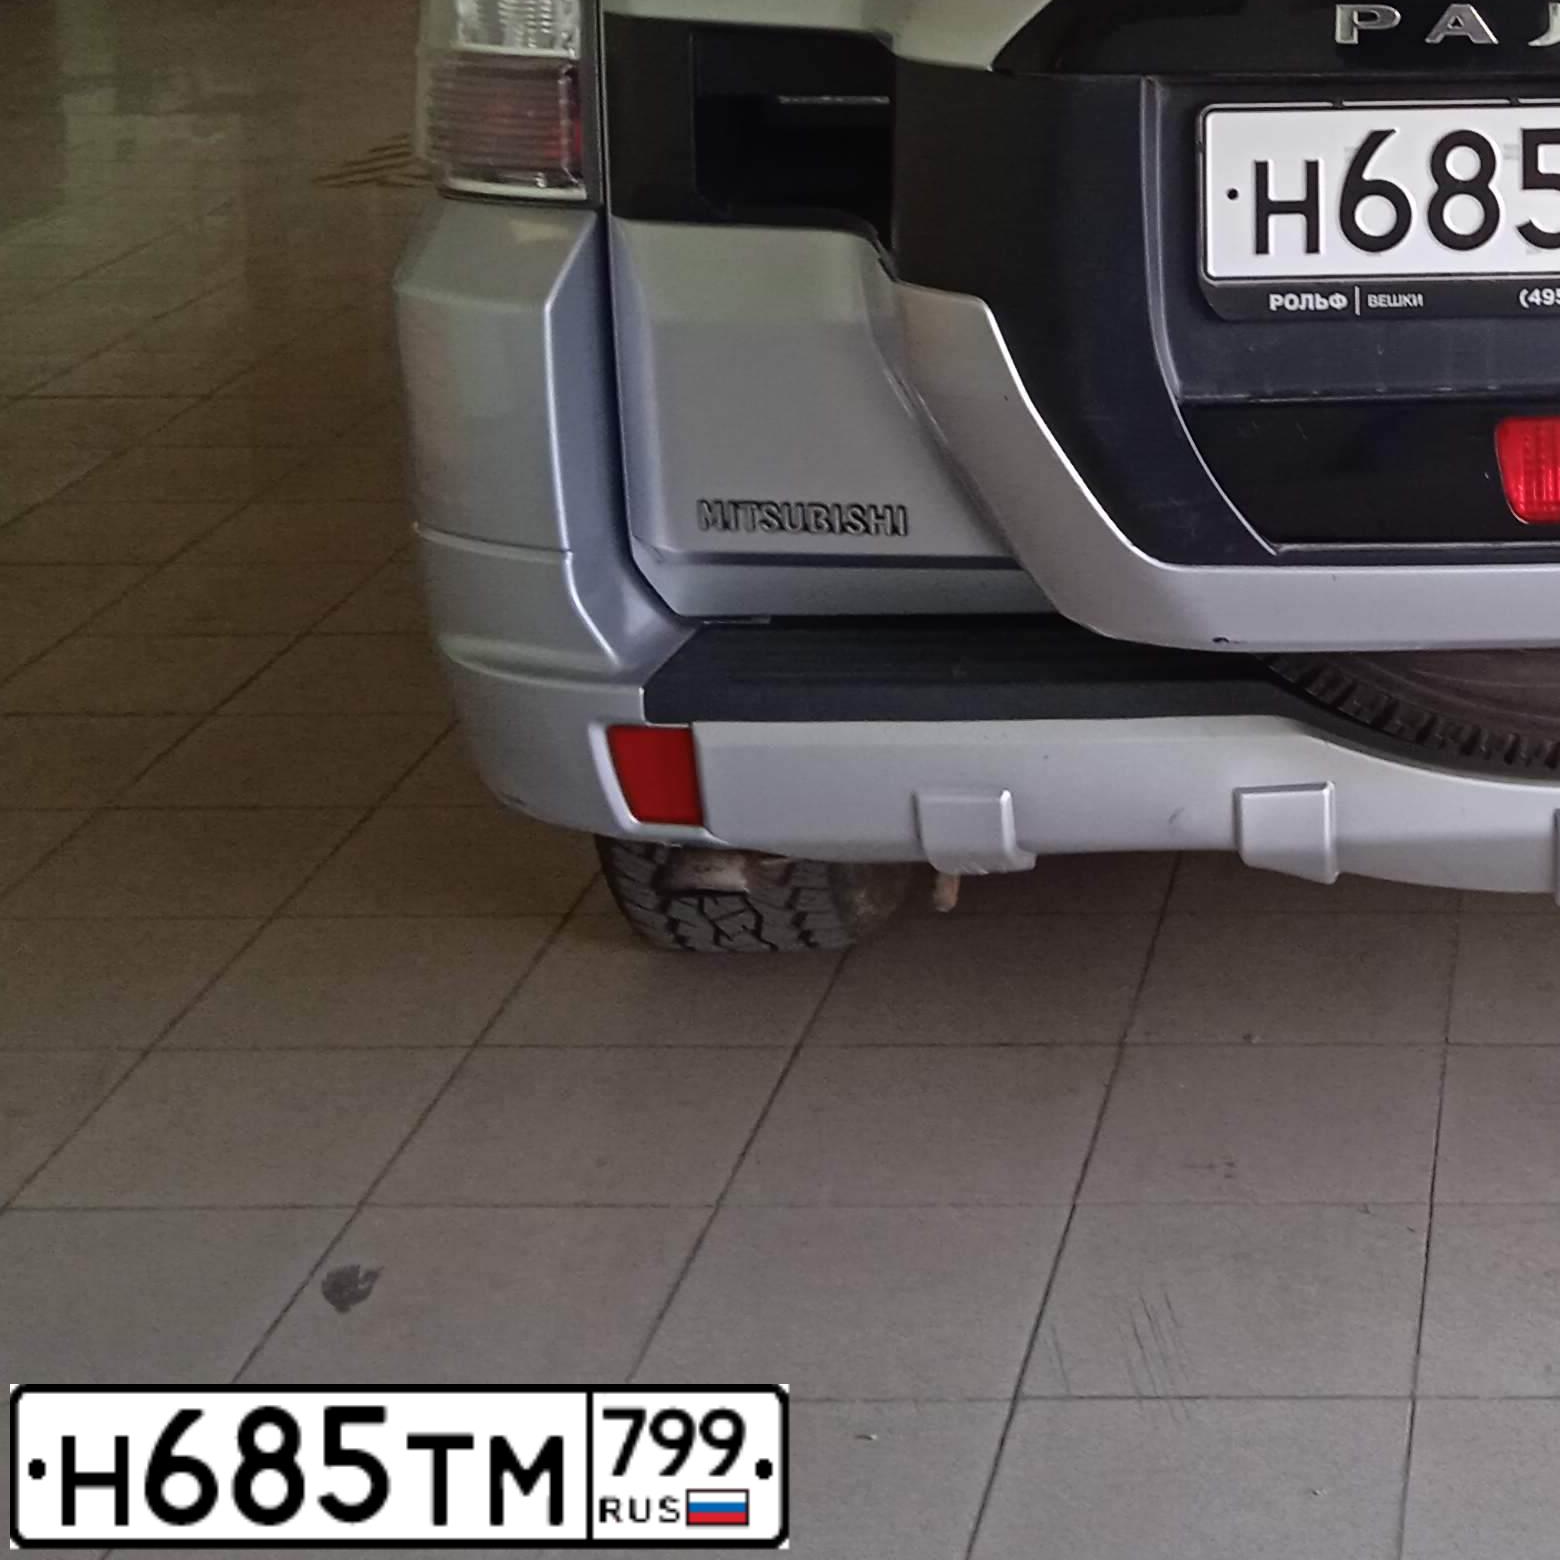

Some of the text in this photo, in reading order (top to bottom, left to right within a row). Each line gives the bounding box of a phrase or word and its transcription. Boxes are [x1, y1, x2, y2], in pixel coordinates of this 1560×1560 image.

[1269, 291, 1348, 312] РОЛЬФ
[1367, 293, 1424, 309] ВЕШКИ
[697, 498, 909, 537] MITSUBISHI
